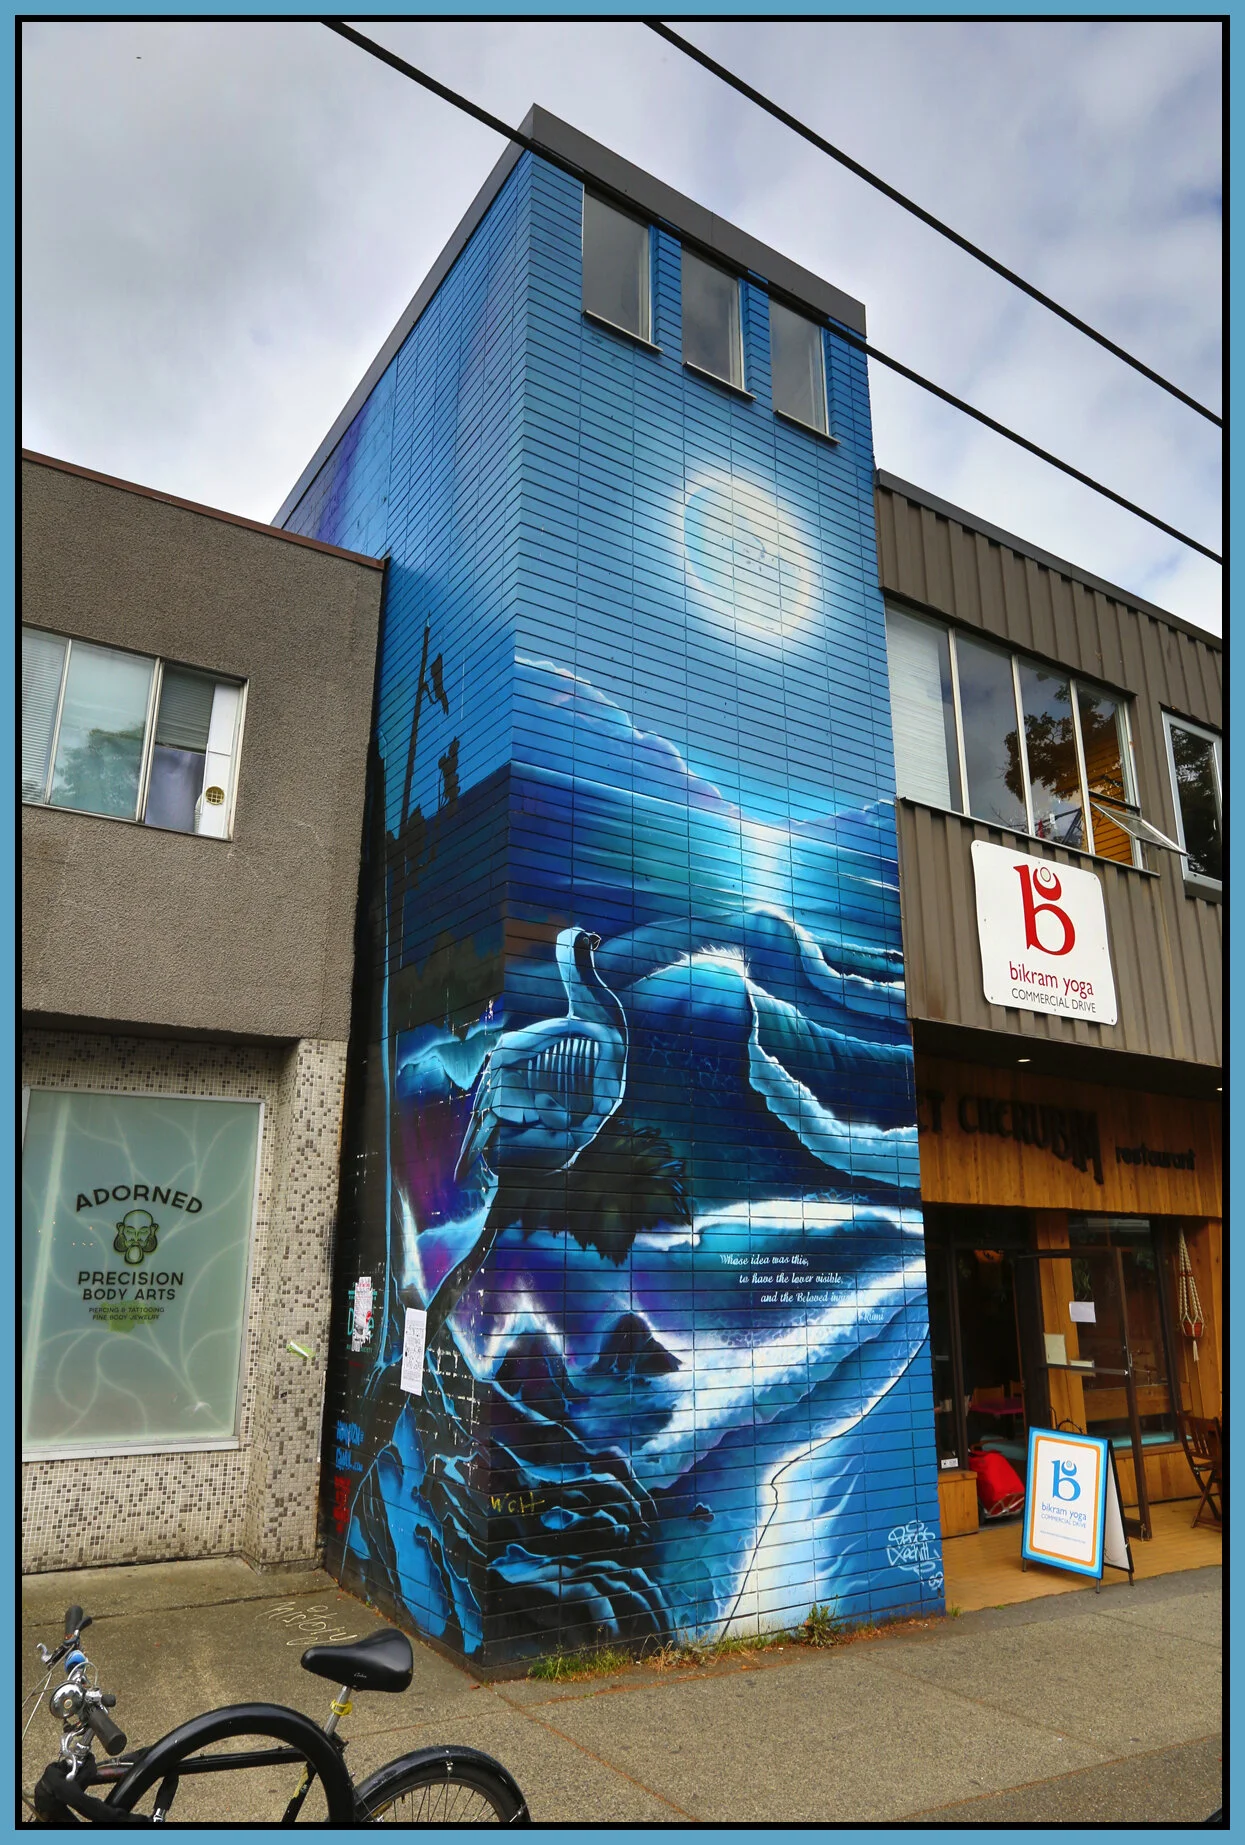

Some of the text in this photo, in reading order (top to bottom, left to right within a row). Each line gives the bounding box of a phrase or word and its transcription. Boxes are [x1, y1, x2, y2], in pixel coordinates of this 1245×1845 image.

[1009, 961, 1094, 1000] bikram yoga
[1011, 988, 1097, 1014] COMMERCIAL DRIVE
[1115, 1143, 1196, 1171] restaurant
[76, 1184, 203, 1214] ADORNED
[750, 1254, 770, 1265] idea
[771, 1256, 790, 1265] was
[791, 1254, 809, 1267] this,
[78, 1271, 184, 1286] PRECISION
[739, 1272, 844, 1285] to have the lover visible,
[83, 1288, 176, 1301] BODY ARTS
[760, 1291, 778, 1303] and
[780, 1291, 794, 1303] the
[796, 1292, 828, 1303] Beloved
[1041, 1501, 1087, 1522] bikram yoga
[1040, 1513, 1086, 1529] COMMERCIAL DRIVE
